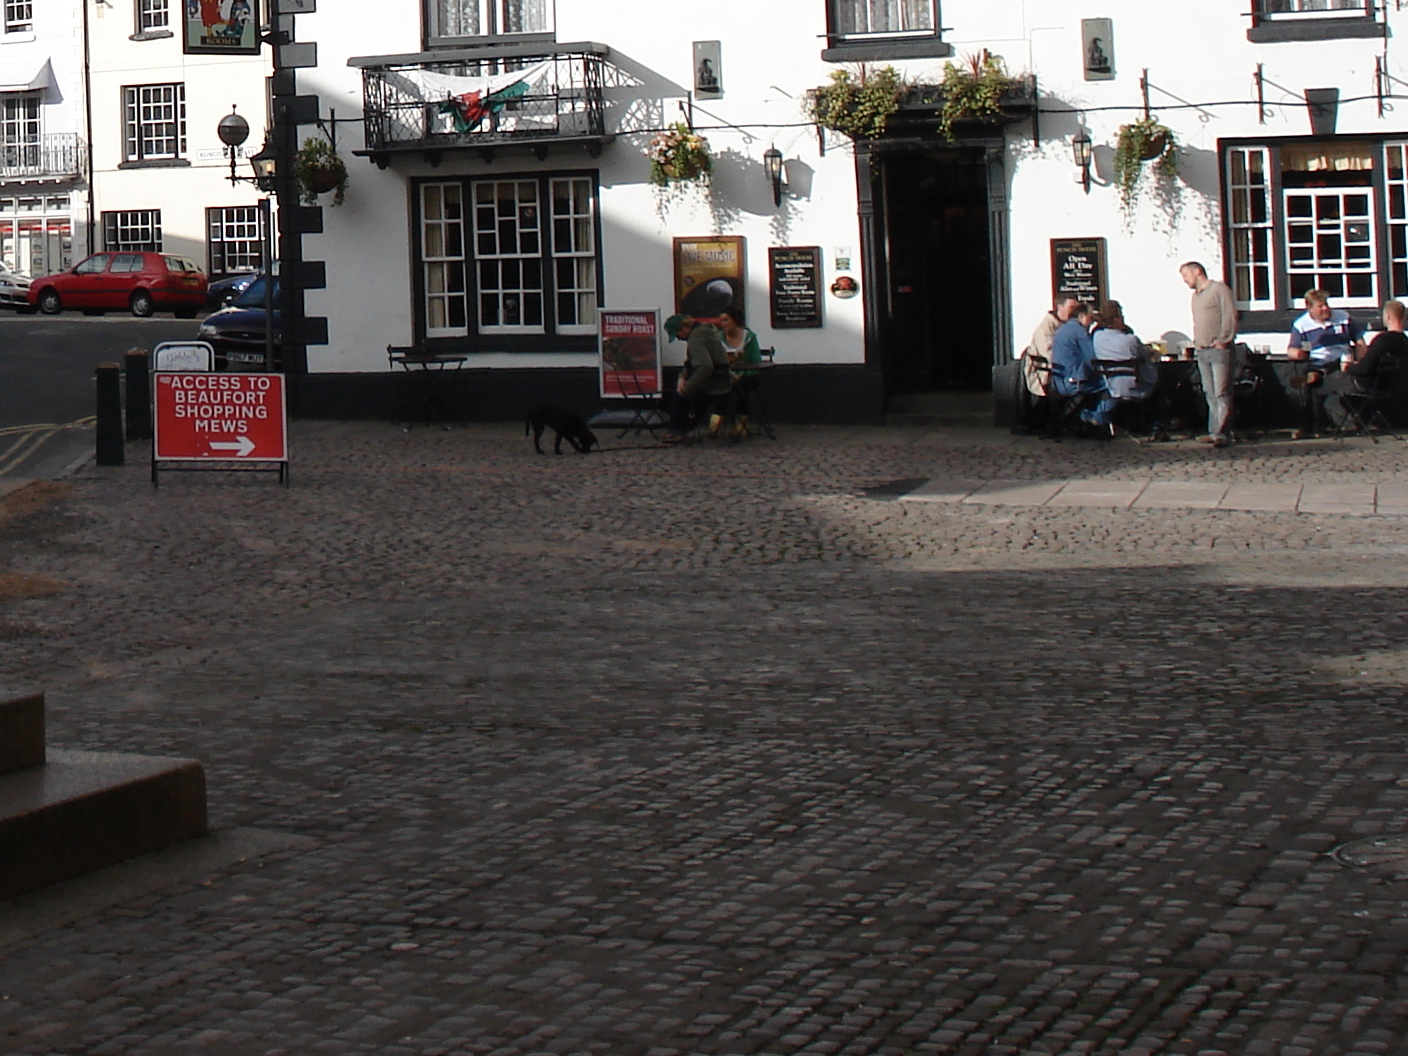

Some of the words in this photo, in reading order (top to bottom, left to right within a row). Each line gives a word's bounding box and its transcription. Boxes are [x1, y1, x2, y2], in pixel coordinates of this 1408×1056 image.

[206, 37, 237, 45] ROOMS
[705, 250, 735, 263] MUSIC
[1063, 262, 1075, 270] All
[605, 315, 648, 324] TRADITIONAL
[633, 324, 655, 333] ROAST
[171, 376, 241, 390] ACCESS
[248, 377, 271, 390] TO
[175, 391, 266, 404] BEAUFORT
[175, 405, 268, 419] SHOPPING
[195, 419, 248, 433] MEWS
